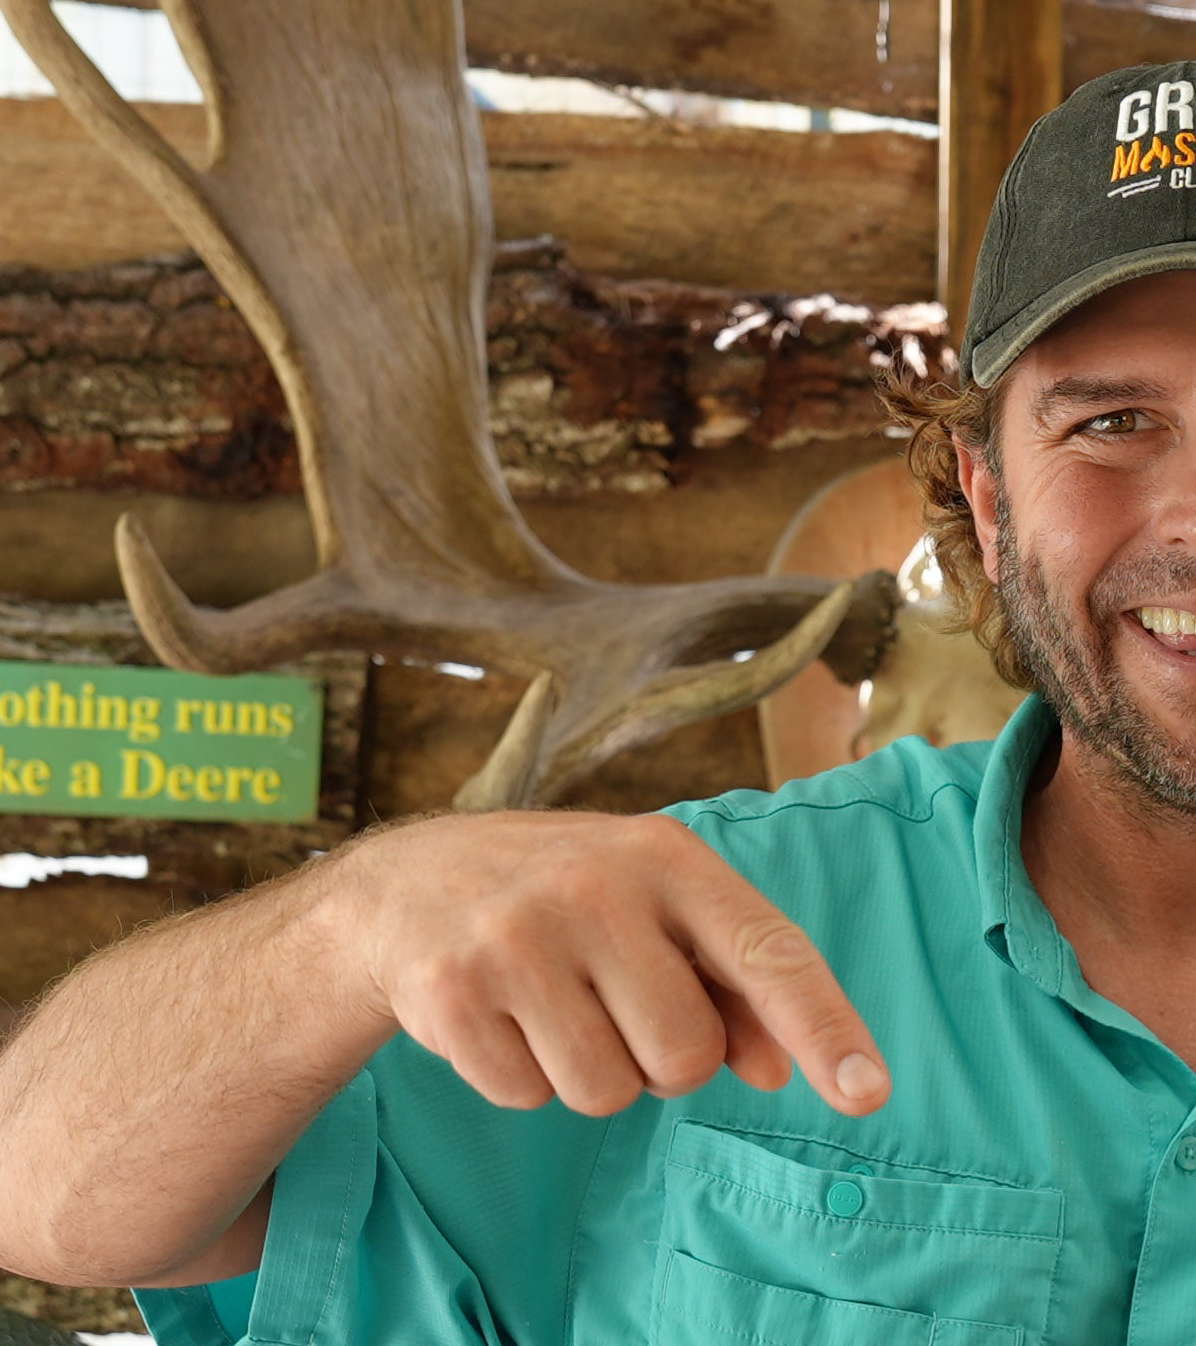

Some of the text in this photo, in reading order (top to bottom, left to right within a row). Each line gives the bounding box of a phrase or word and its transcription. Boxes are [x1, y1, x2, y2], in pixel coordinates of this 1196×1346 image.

[0, 680, 295, 743] othing runs
[68, 760, 101, 798] a
[119, 748, 281, 804] Deere
